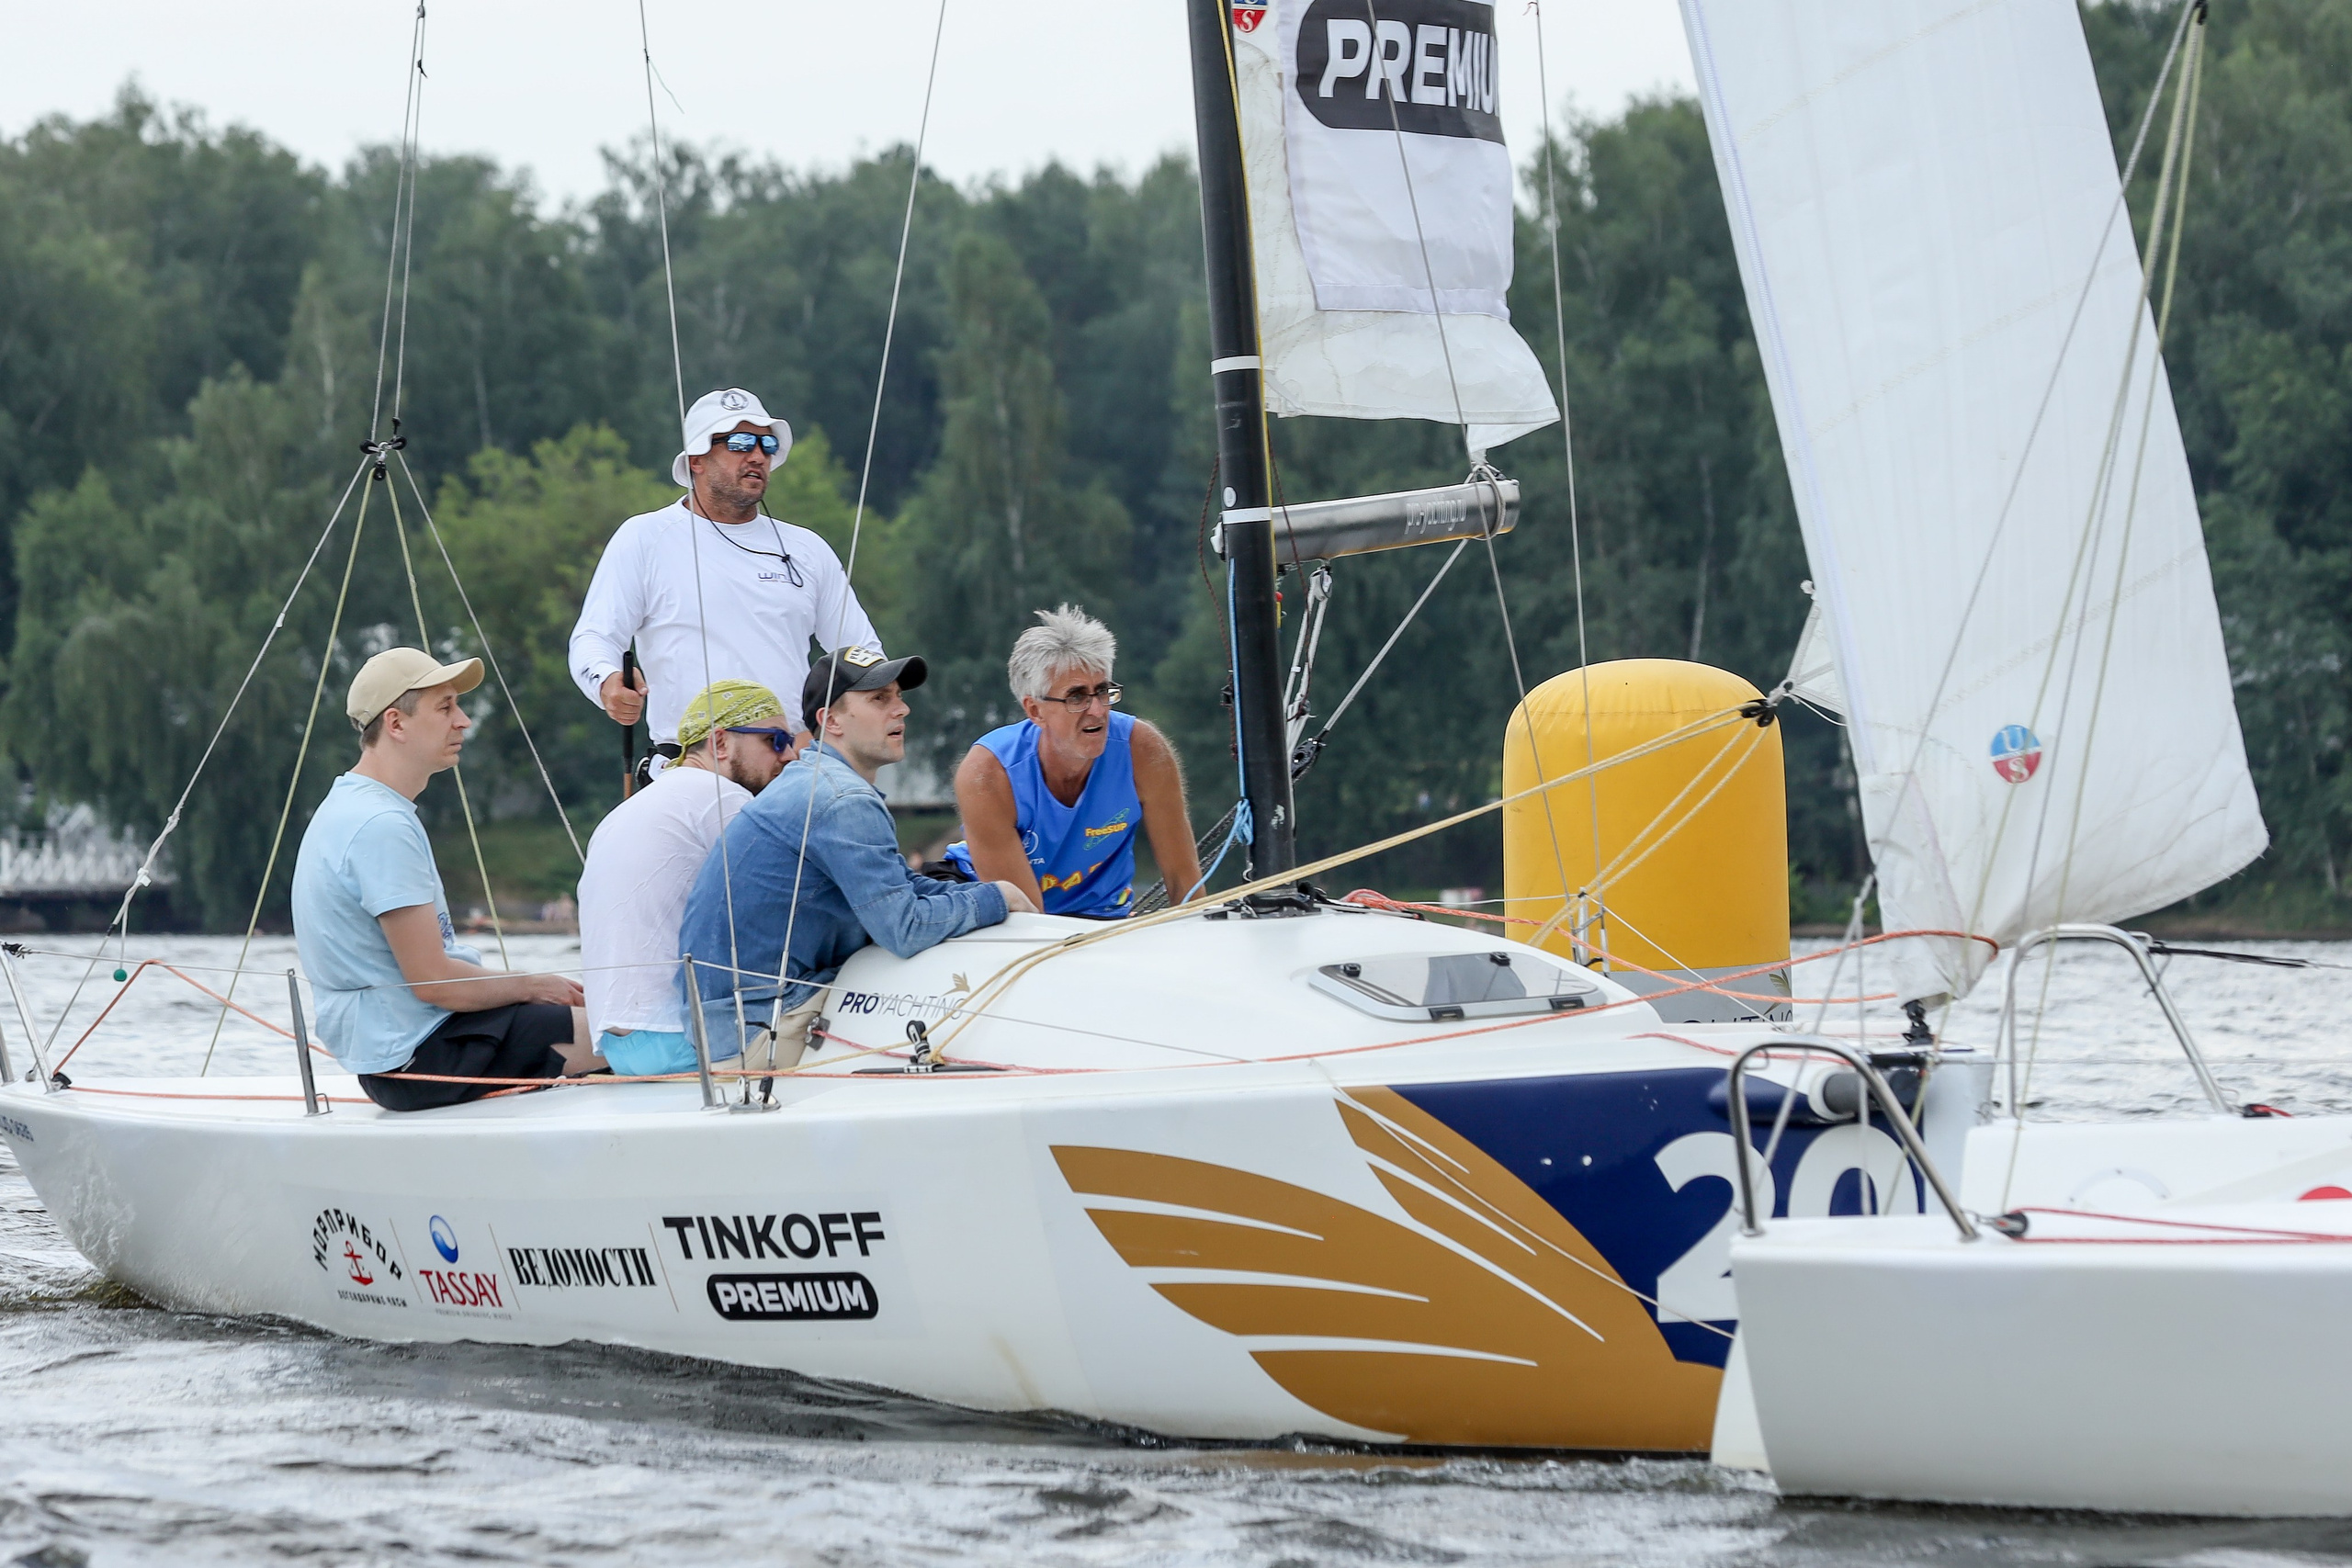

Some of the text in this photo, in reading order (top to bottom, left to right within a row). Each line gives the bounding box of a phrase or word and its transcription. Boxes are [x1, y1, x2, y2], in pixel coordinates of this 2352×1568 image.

[1318, 19, 1498, 116] PREMIU
[838, 992, 966, 1020] PROYACHTING
[312, 1208, 402, 1280] МОРПРИБОР
[662, 1212, 886, 1259] TINKOFF
[419, 1269, 503, 1307] TASSAY
[507, 1247, 656, 1292] ВЕДОМОСТИ
[715, 1280, 869, 1313] PREMIUM
